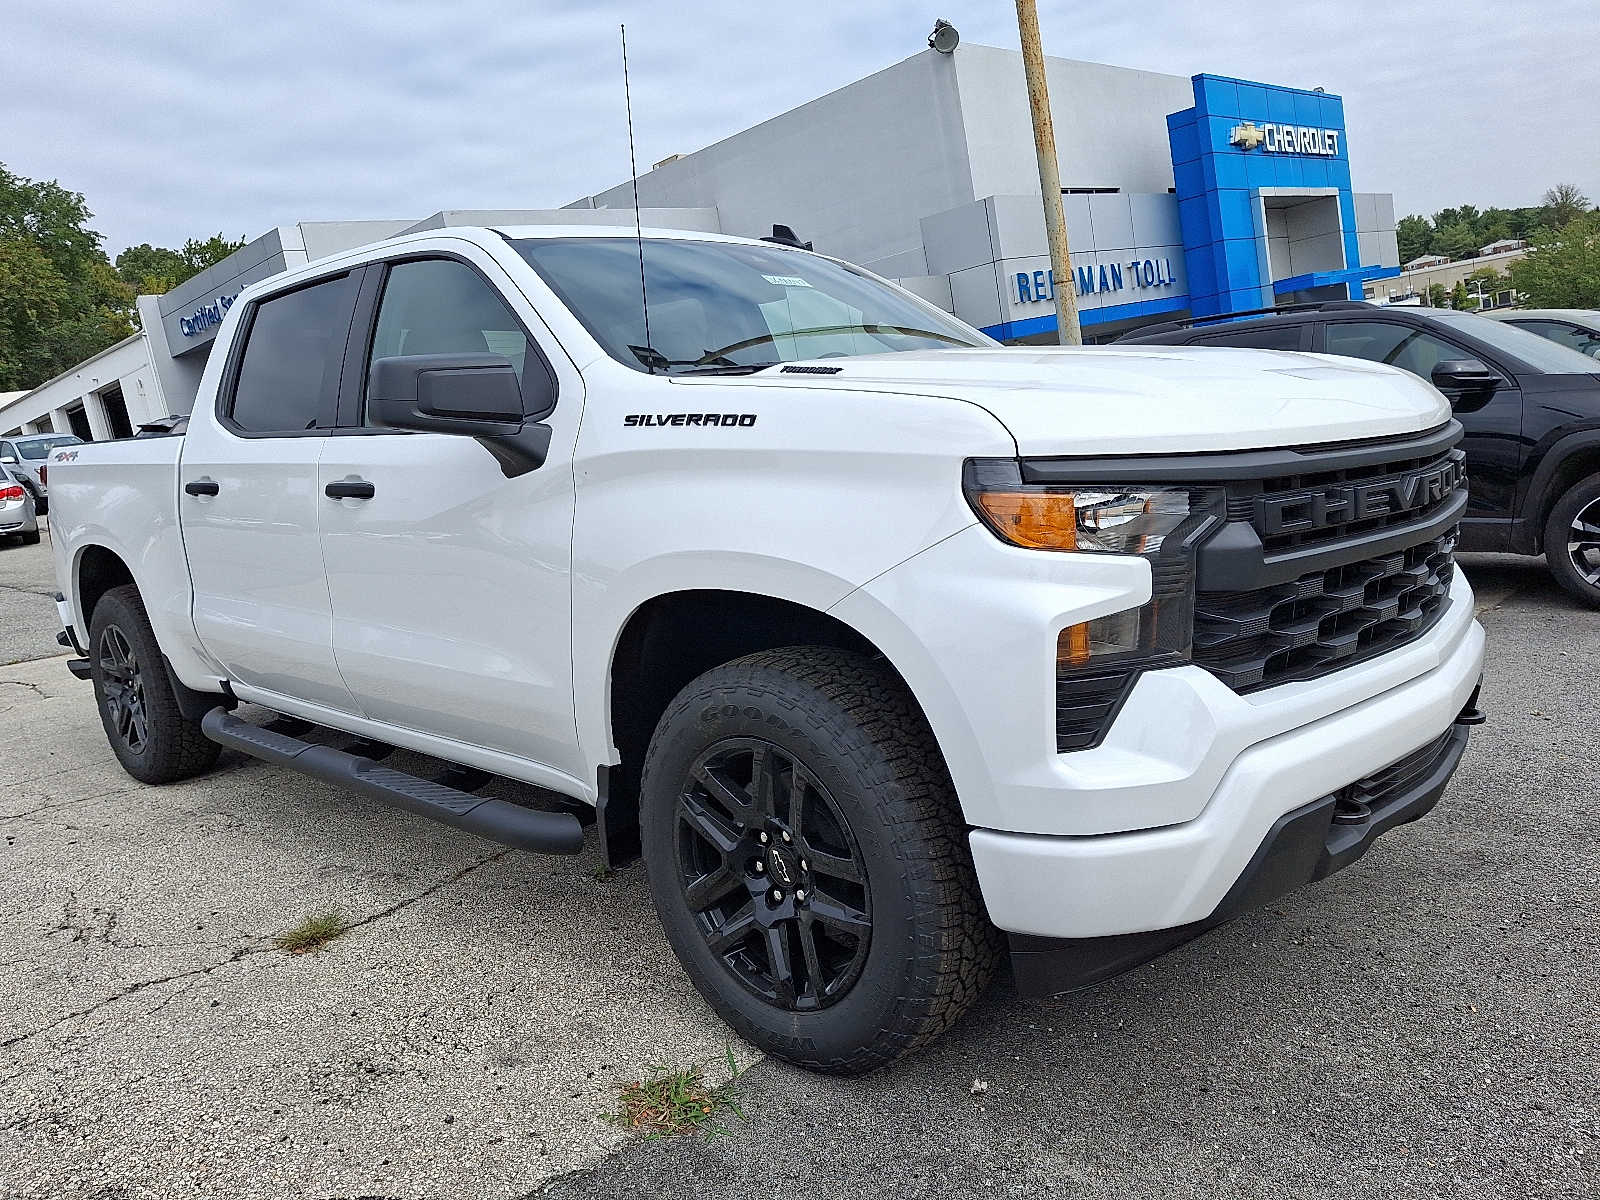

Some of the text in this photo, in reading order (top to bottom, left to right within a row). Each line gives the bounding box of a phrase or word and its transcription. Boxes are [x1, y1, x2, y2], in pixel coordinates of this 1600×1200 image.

[1264, 124, 1339, 155] CHEVROLET
[1012, 257, 1177, 303] REMAN TOLL
[180, 298, 223, 337] Certified
[623, 413, 757, 427] SILVERADO
